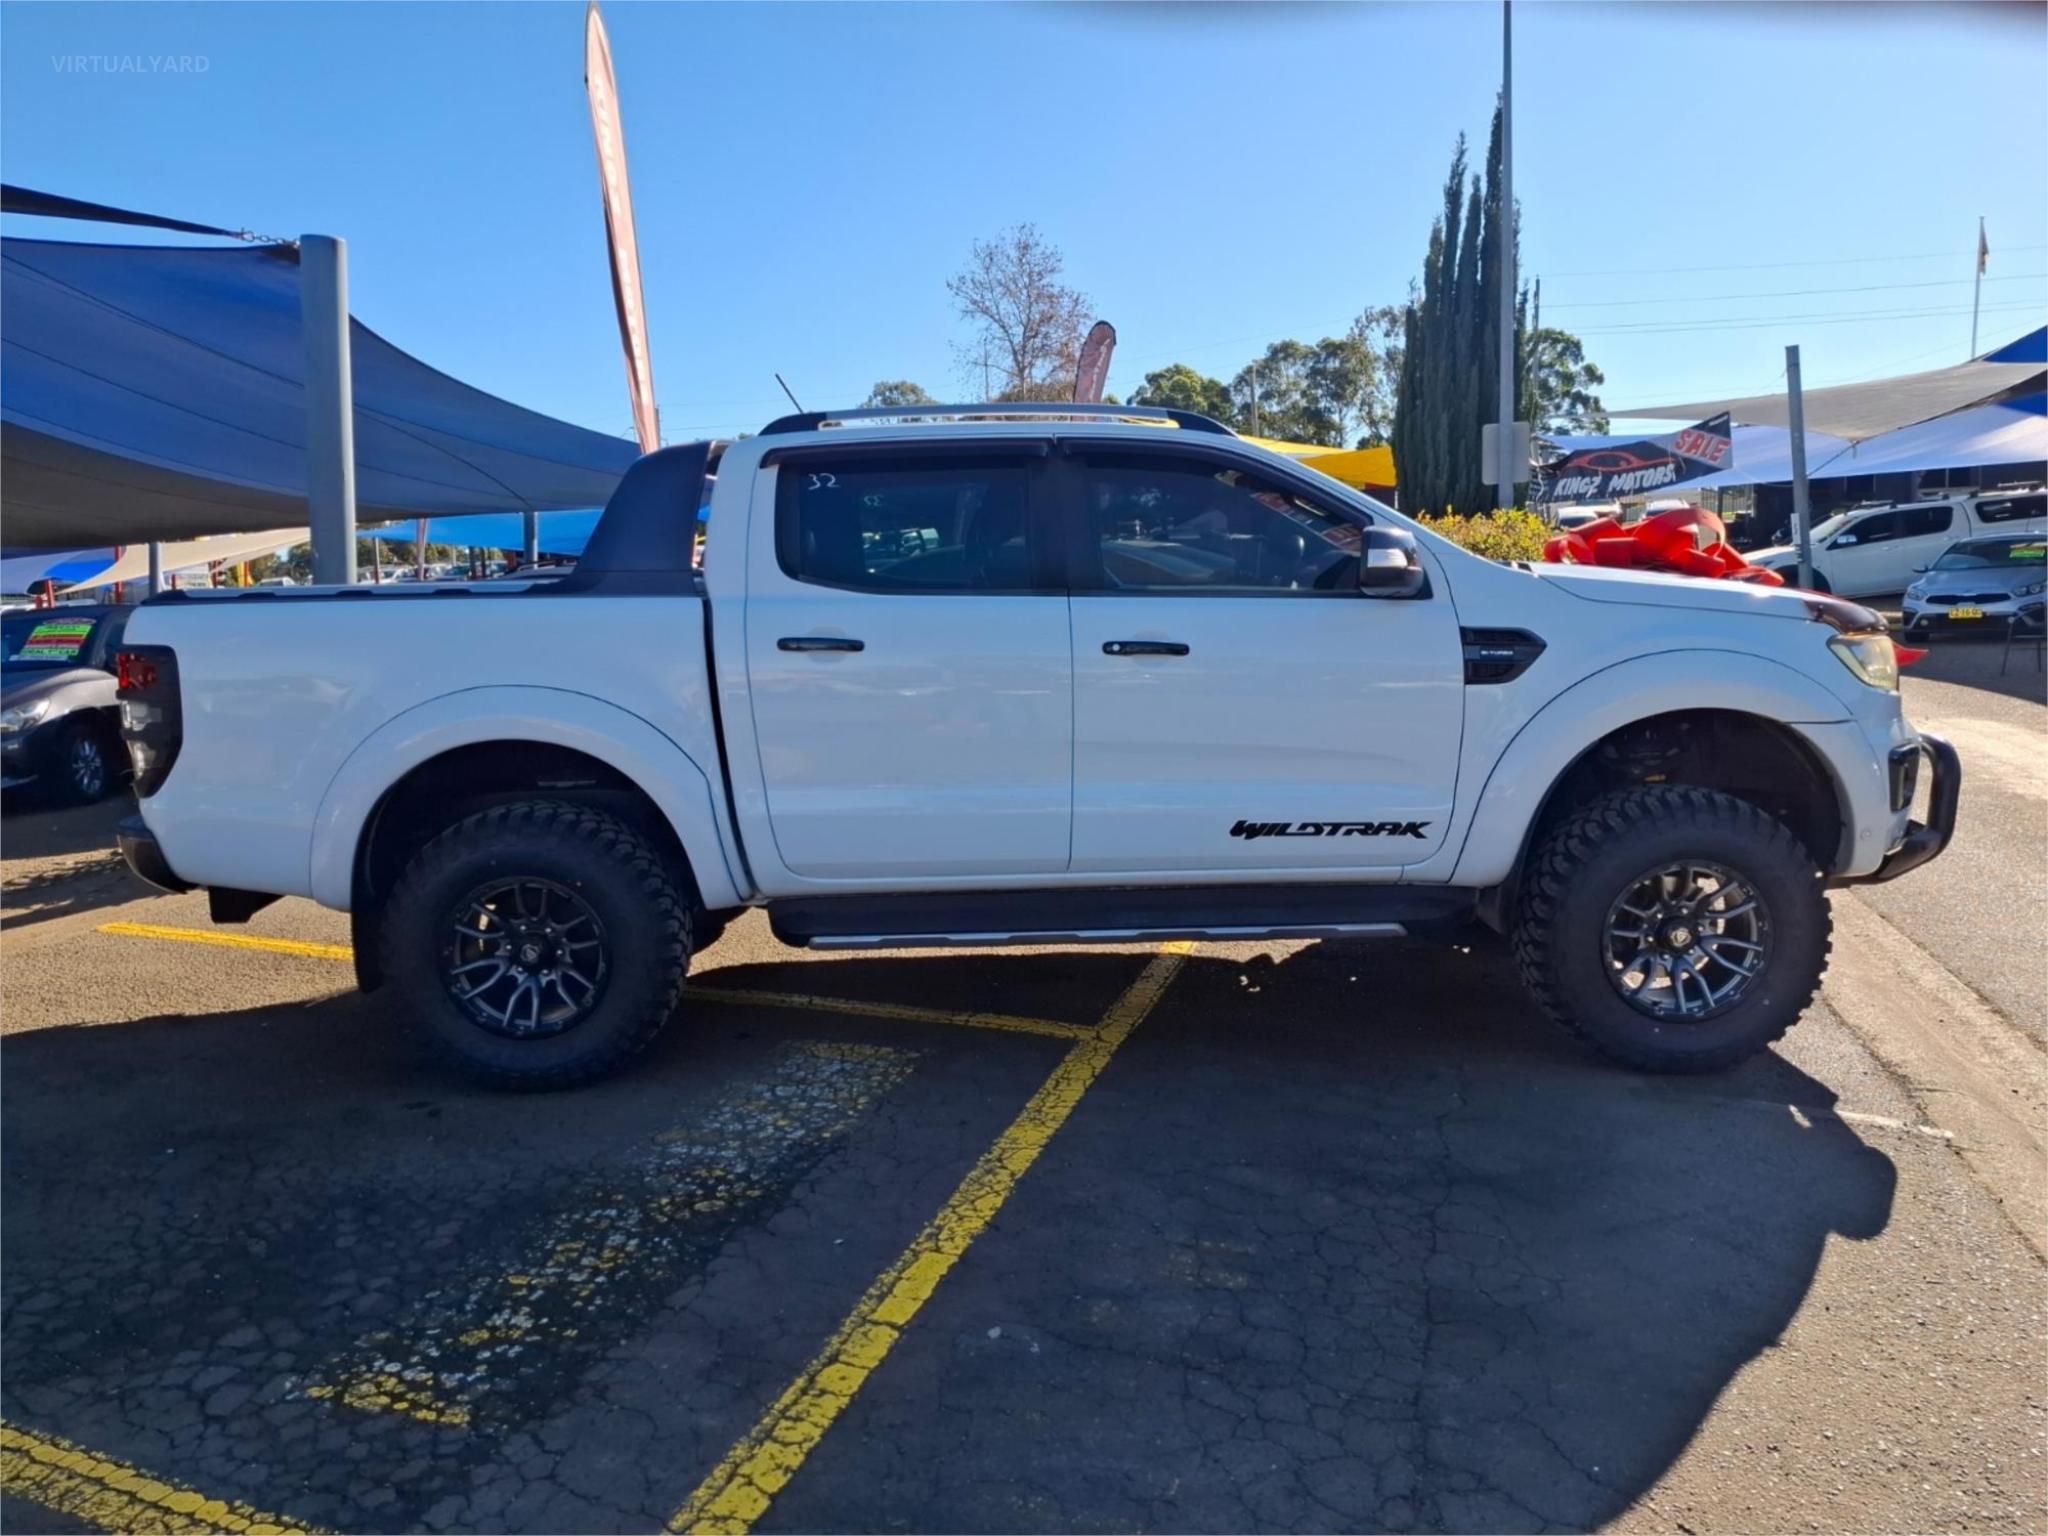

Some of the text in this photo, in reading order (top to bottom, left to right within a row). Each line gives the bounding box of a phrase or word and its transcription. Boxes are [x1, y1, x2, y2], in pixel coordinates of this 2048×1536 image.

[1673, 428, 1731, 463] SALE
[807, 472, 840, 490] 32
[1554, 463, 1675, 498] KINGZ MOTORS
[1229, 820, 1432, 840] WILDTRAK
